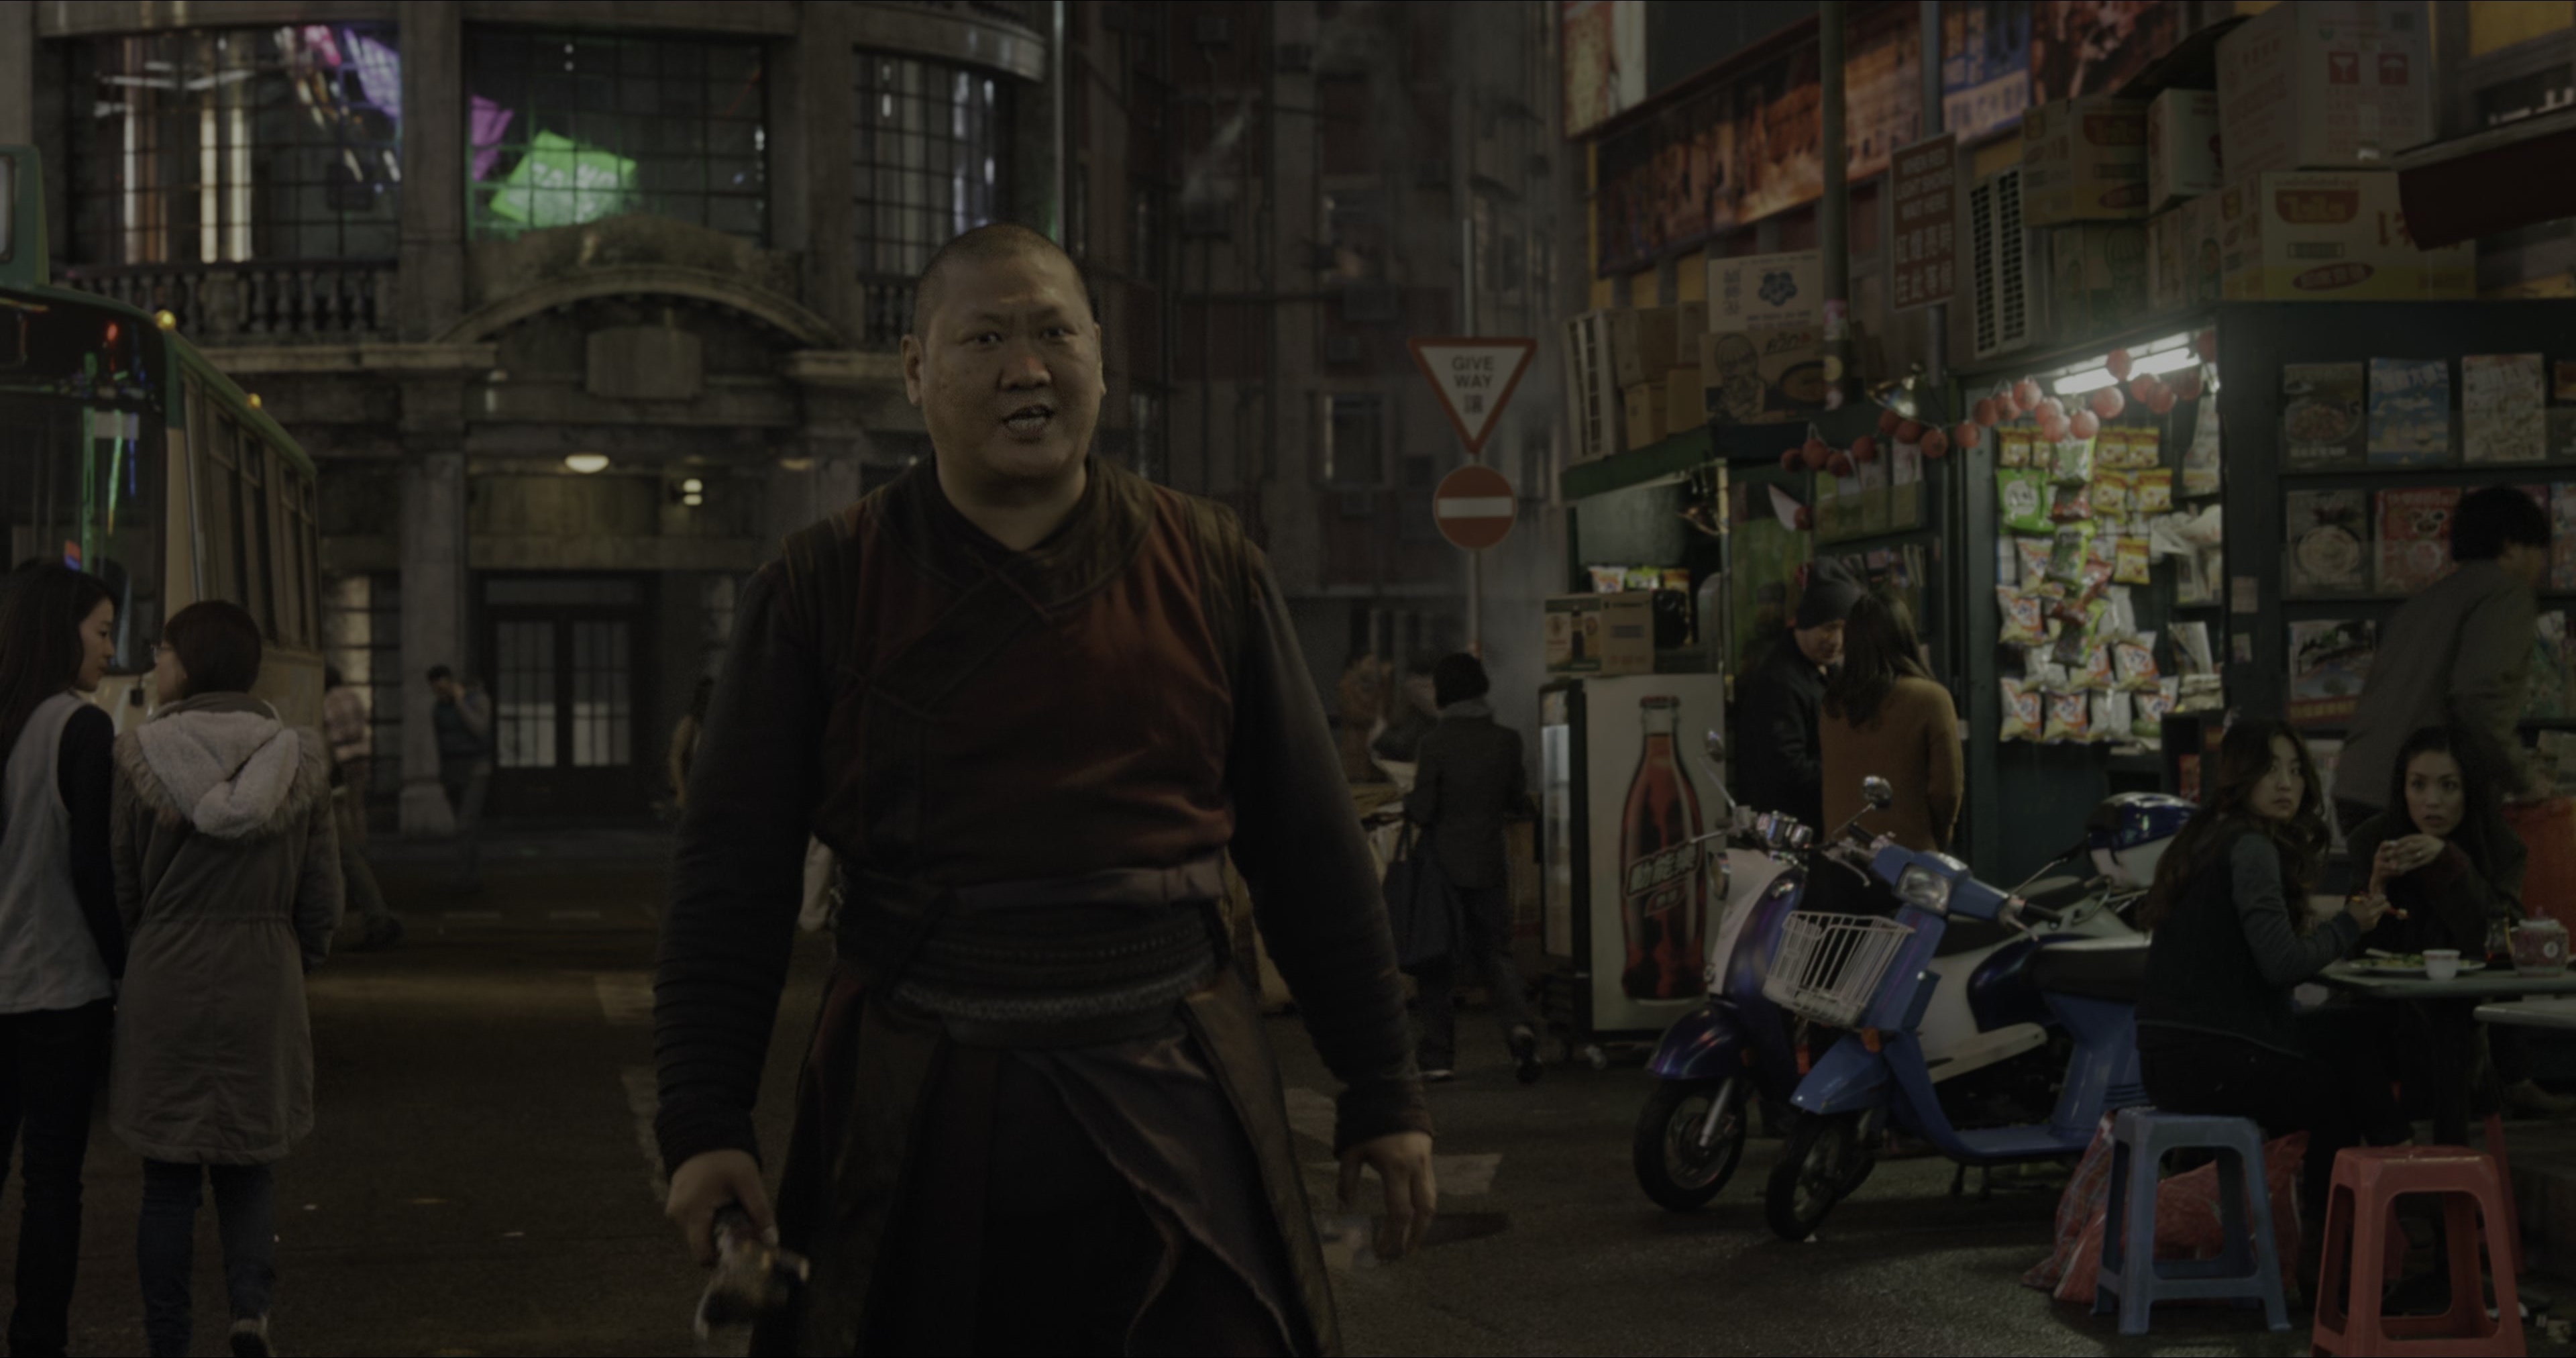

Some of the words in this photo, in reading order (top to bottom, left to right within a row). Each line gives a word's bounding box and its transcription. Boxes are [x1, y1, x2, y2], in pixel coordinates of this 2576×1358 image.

[1901, 154, 1927, 176] WHEN
[1929, 147, 1947, 168] RED
[1896, 178, 1921, 201] LIGHT
[1922, 167, 1953, 193] SHOWS
[1901, 200, 1922, 221] WAIT
[1923, 191, 1948, 215] HERE
[1452, 355, 1495, 372] GIVE
[1454, 374, 1493, 388] WAY
